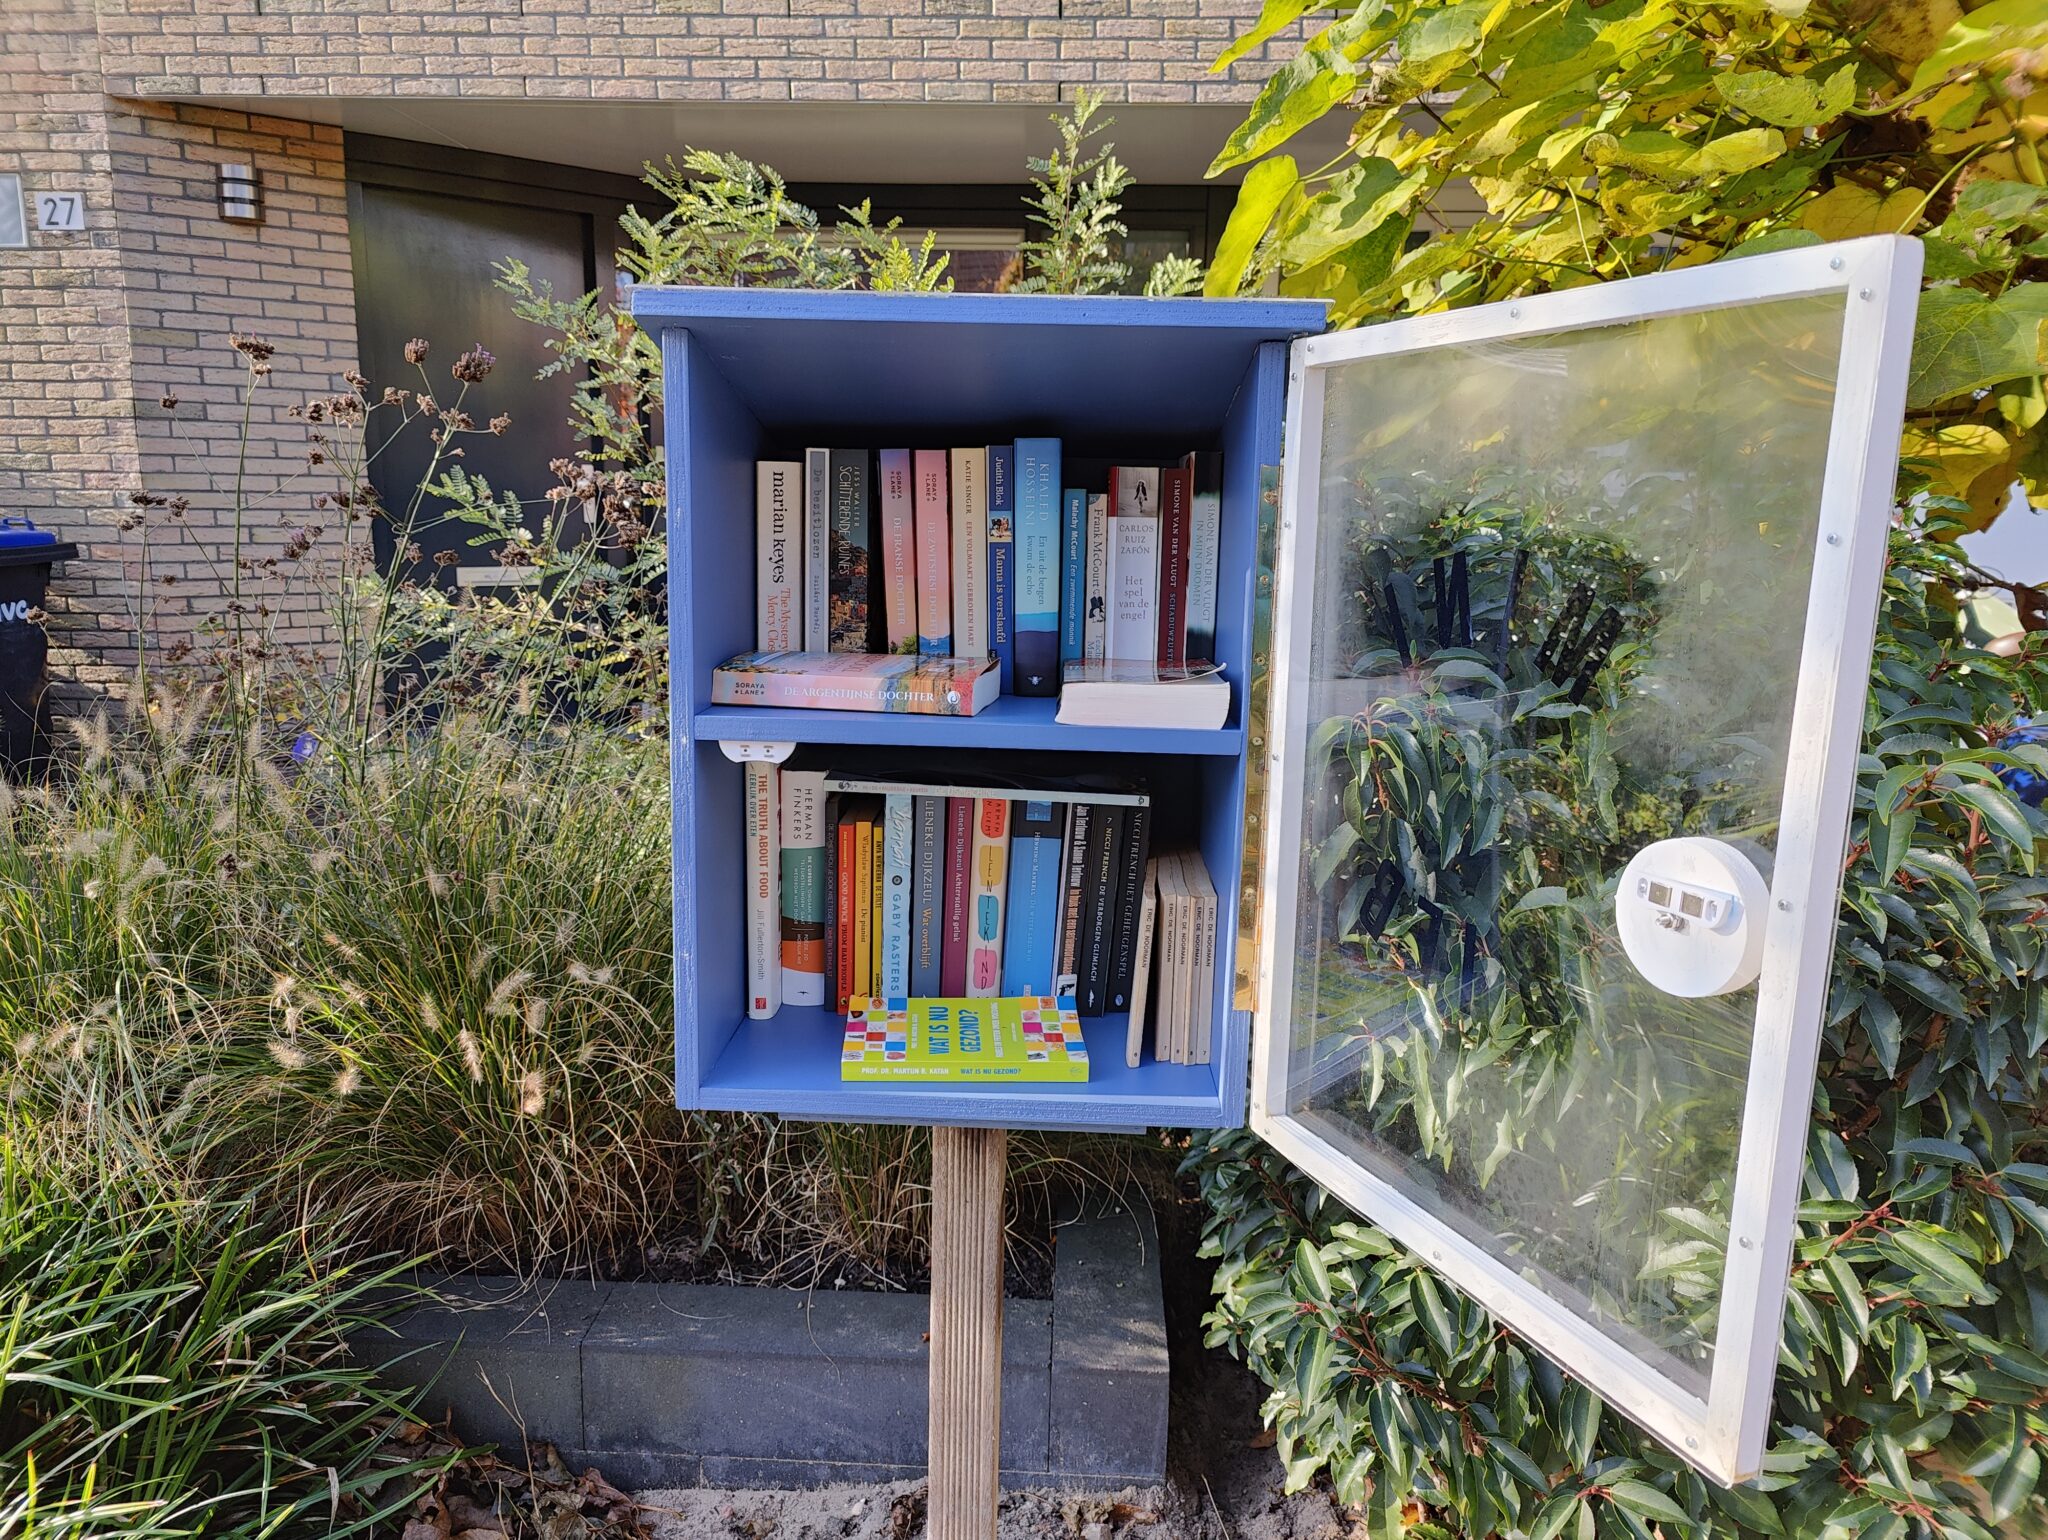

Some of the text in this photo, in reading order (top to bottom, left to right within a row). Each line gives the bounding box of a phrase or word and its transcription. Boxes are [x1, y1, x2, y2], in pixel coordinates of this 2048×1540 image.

[43, 197, 75, 226] 27
[995, 456, 1004, 505] Judith Blok
[1025, 457, 1036, 526] HOSSEINI
[1039, 463, 1049, 521] KHALED
[768, 471, 787, 584] marian keyes
[812, 470, 822, 560] De bezitlozen
[838, 465, 852, 575] SCHITTERENDE RUINES
[1070, 499, 1079, 560] Malachy McCourt
[1119, 525, 1154, 533] CARLOS
[1172, 517, 1180, 537] VAN
[1207, 503, 1215, 542] SIMONE
[1039, 535, 1047, 548] En
[1092, 508, 1103, 588] Frank McCourt
[1121, 545, 1150, 554] ZAFÓN
[1125, 536, 1146, 544] RUIZ
[1026, 535, 1035, 596] kwam de echo
[1038, 565, 1047, 576] de
[1070, 564, 1078, 578] Een
[1125, 576, 1143, 585] Het
[966, 583, 974, 626] GEBROKEN
[996, 548, 1006, 644] Mama is verslaafd
[1036, 577, 1047, 606] bergen
[1119, 598, 1149, 608] van de
[1124, 586, 1143, 598] spel
[1203, 591, 1211, 623] VLUGT
[0, 600, 27, 622] VC
[766, 595, 778, 652] Mercy Clos
[779, 588, 791, 652] The Mystery
[1120, 610, 1146, 621] engel
[785, 687, 934, 701] DE ARGENTIJNSE DOCHTER
[793, 788, 802, 841] FINKERS
[805, 788, 813, 841] HERMAN
[1074, 816, 1089, 841] Terlouw
[1077, 805, 1089, 817] Jan
[758, 774, 769, 899] THE TRUTH ABOUT FOOD
[922, 800, 934, 904] LIENEKE DIJKZEUL
[1072, 846, 1086, 864] Sanne
[1101, 849, 1110, 883] FRENCH
[953, 805, 965, 943] Lieneke Dijkzeul Achterstallig geluk
[1070, 864, 1084, 888] Terlouw
[1099, 885, 1106, 896] DE
[1117, 812, 1142, 980] NICCI FRENCH HET GEHEUGENSPEL
[859, 907, 867, 944] De pianist
[1094, 896, 1105, 942] VERBORGEN
[1145, 924, 1151, 934] DE
[1168, 920, 1173, 929] DE
[1182, 921, 1187, 931] DE
[1196, 922, 1201, 932] DE
[1207, 923, 1213, 933] DE
[757, 921, 765, 981] Fullerton-Smith
[891, 894, 901, 992] GABY RASTERS
[919, 907, 931, 968] Wat overblijft
[1142, 935, 1150, 969] NOORMAN
[1090, 943, 1100, 983] GLIMLACH
[929, 1006, 950, 1055] WAT IS NU
[959, 1009, 982, 1053] GEZOND?
